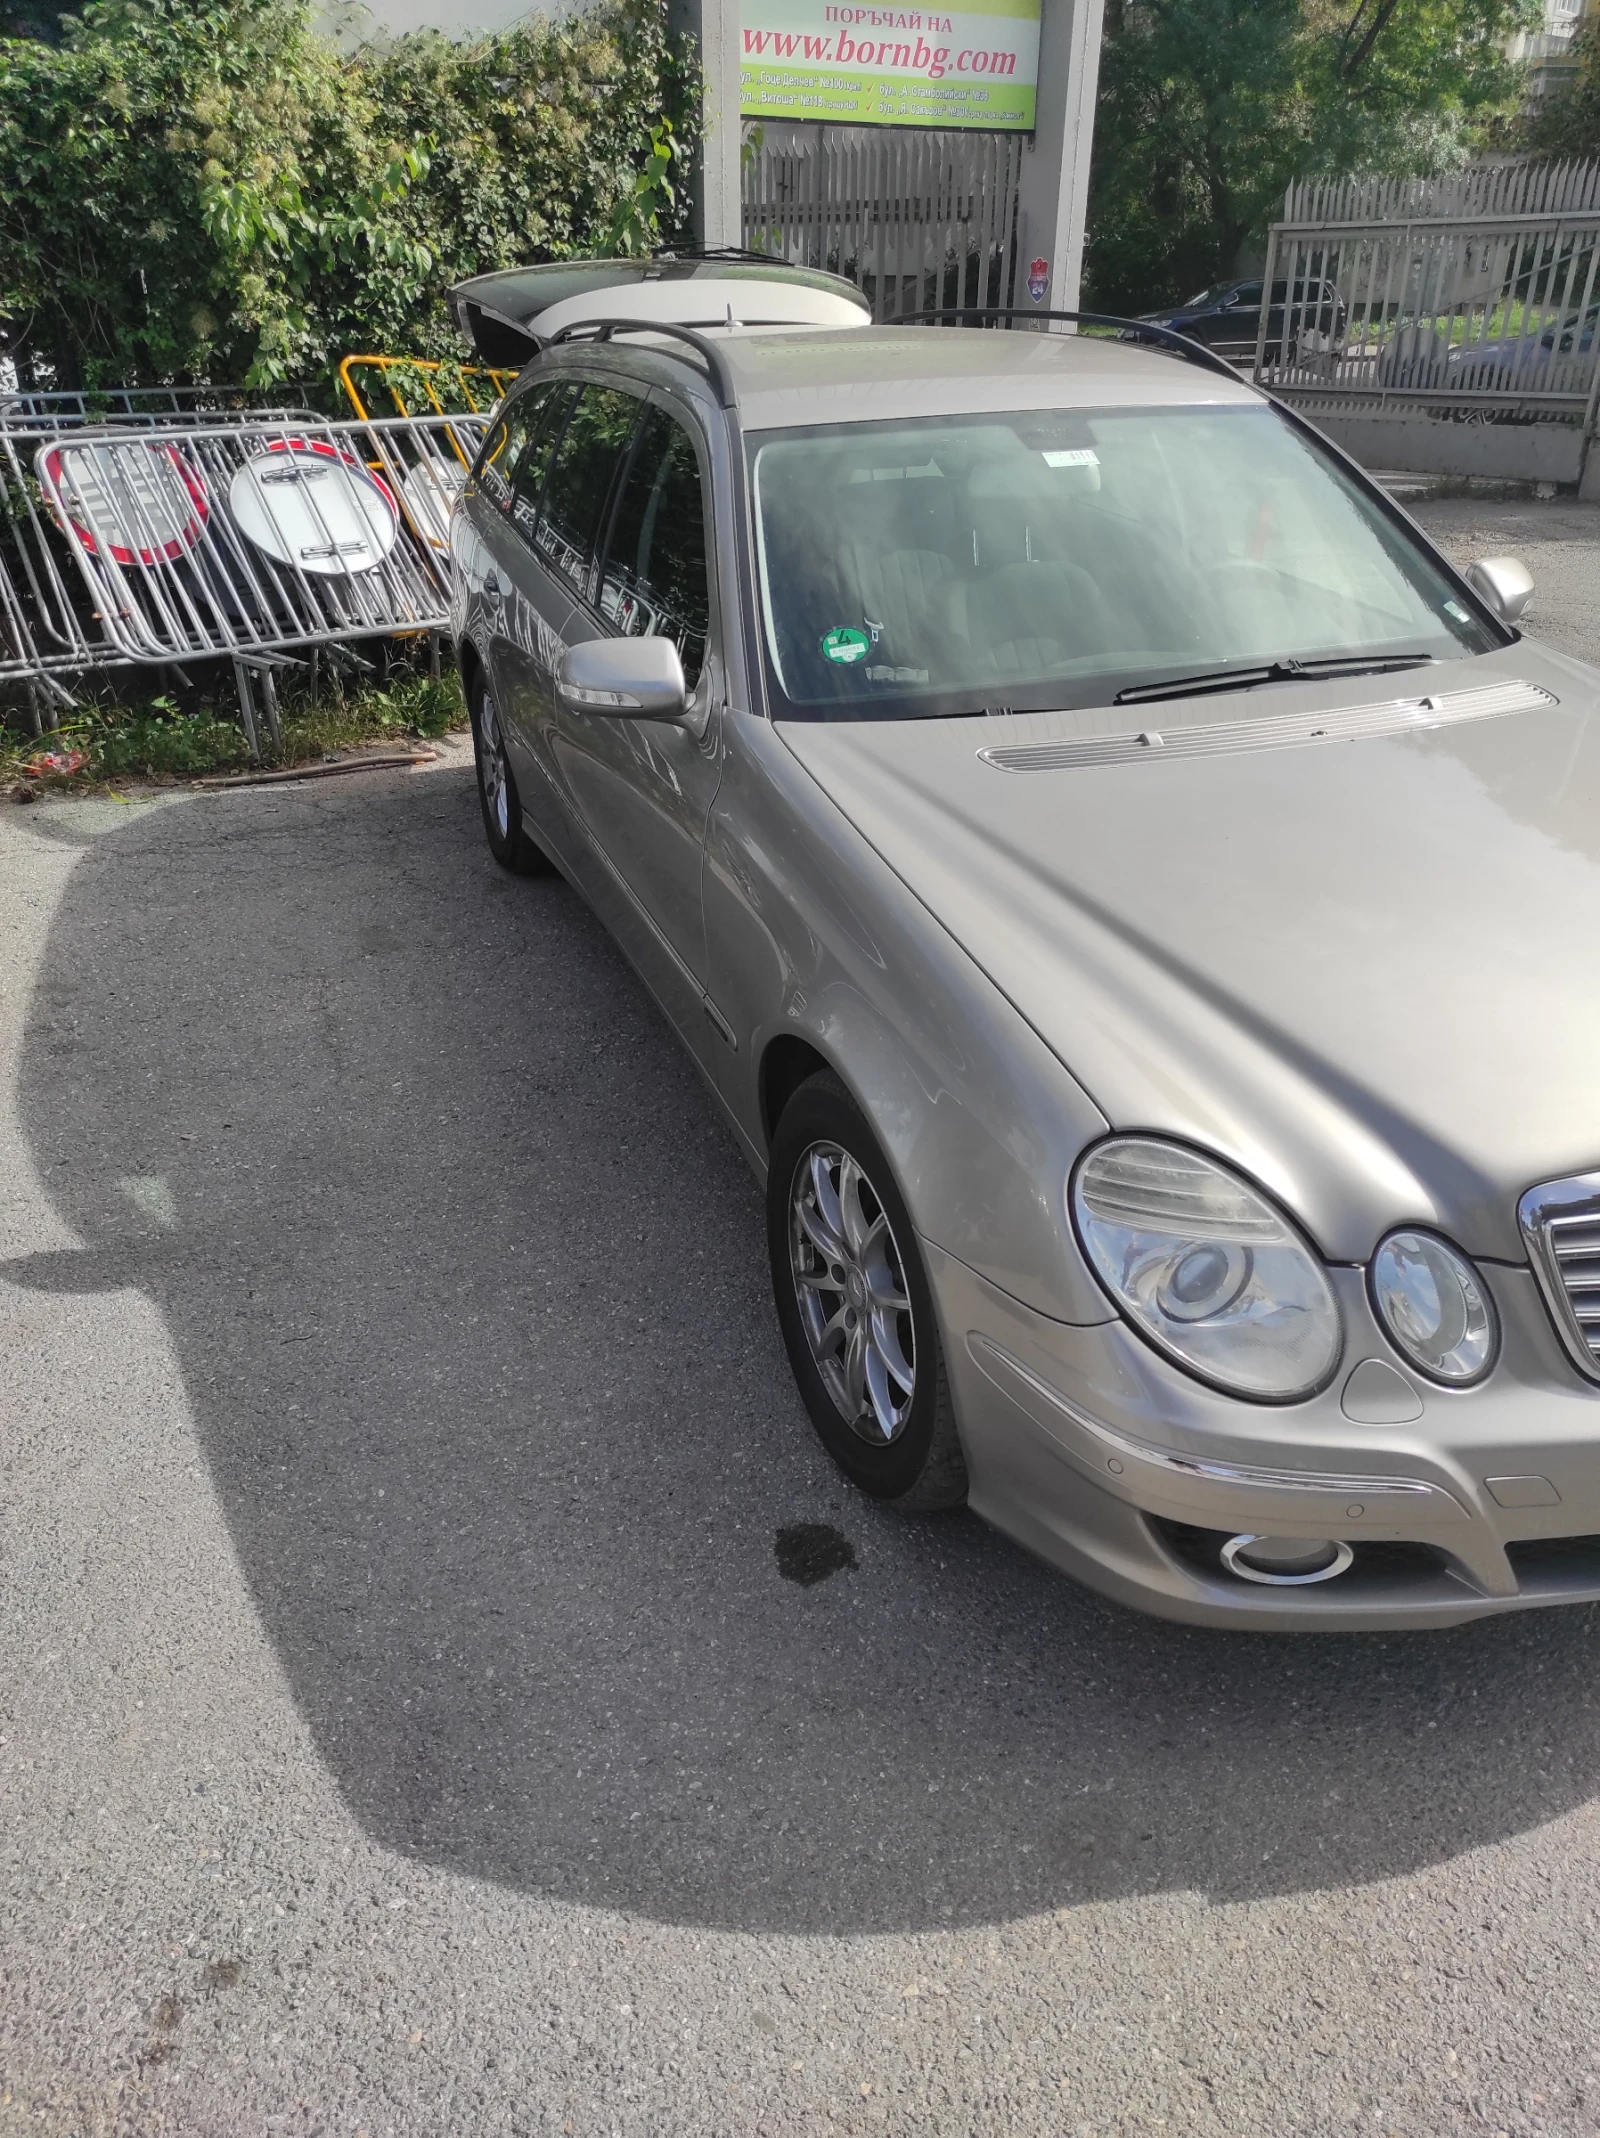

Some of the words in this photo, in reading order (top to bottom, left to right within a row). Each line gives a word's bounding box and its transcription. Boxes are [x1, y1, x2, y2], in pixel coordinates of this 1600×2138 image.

[825, 6, 921, 30] ПОРЪЧАЙ
[928, 17, 953, 33] НА
[743, 29, 1017, 79] www.bornbg.com
[740, 71, 753, 85] ул.
[820, 76, 844, 91] №100
[756, 90, 798, 106] „Витоша“
[1032, 283, 1044, 295] 24
[838, 629, 851, 645] 4
